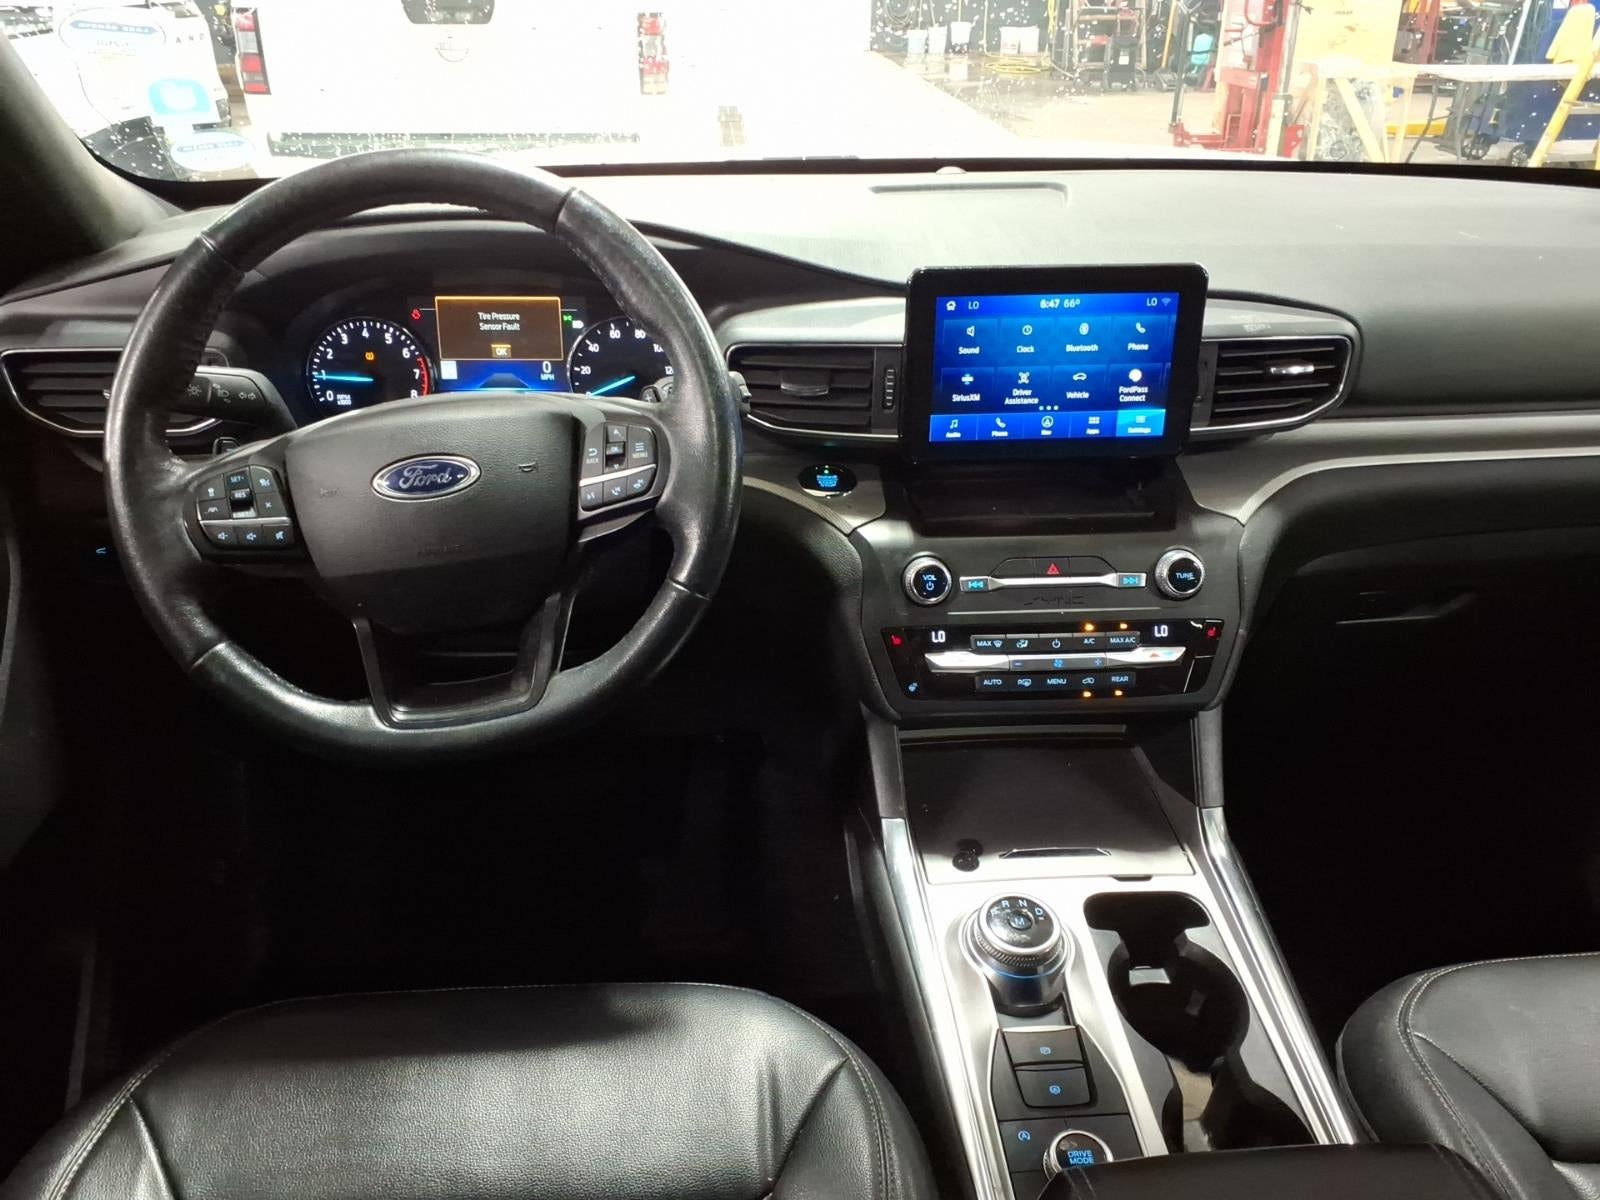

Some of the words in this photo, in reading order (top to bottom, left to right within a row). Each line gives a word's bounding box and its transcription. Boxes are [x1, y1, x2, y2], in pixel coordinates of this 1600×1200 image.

[968, 301, 979, 310] LO
[1040, 298, 1060, 309] 6:47
[1146, 297, 1157, 306] LO
[478, 312, 491, 320] Tire
[492, 312, 520, 320] Pressure
[362, 328, 369, 338] 4
[609, 329, 620, 339] 60
[635, 329, 646, 339] 80
[341, 333, 348, 344] 3
[385, 333, 392, 344] 5
[588, 343, 600, 352] 40
[959, 346, 980, 355] Sound
[1016, 345, 1034, 353] Clock
[1066, 344, 1099, 352] Bluetooth
[1128, 342, 1149, 351] Phone
[326, 349, 333, 359] 2
[402, 348, 410, 358] 6
[495, 347, 508, 356] OK
[543, 361, 551, 373] 0
[580, 366, 591, 374] 20
[413, 369, 420, 379] 7
[540, 373, 555, 381] MPH
[1012, 388, 1032, 396] Driver
[1119, 386, 1148, 394] FordPass
[326, 391, 334, 401] 0
[952, 393, 981, 402] SiriusXM
[1066, 391, 1089, 399] Vehicle
[1004, 397, 1039, 405] Assistance
[398, 464, 452, 489] Ford
[1175, 572, 1195, 580] TUNE
[1154, 624, 1169, 637] LO
[931, 630, 946, 643] LO
[1018, 899, 1028, 907] N
[1034, 907, 1043, 916] D
[1014, 917, 1025, 925] M
[1067, 1150, 1093, 1158] DRIVE
[1069, 1157, 1095, 1165] MODE
